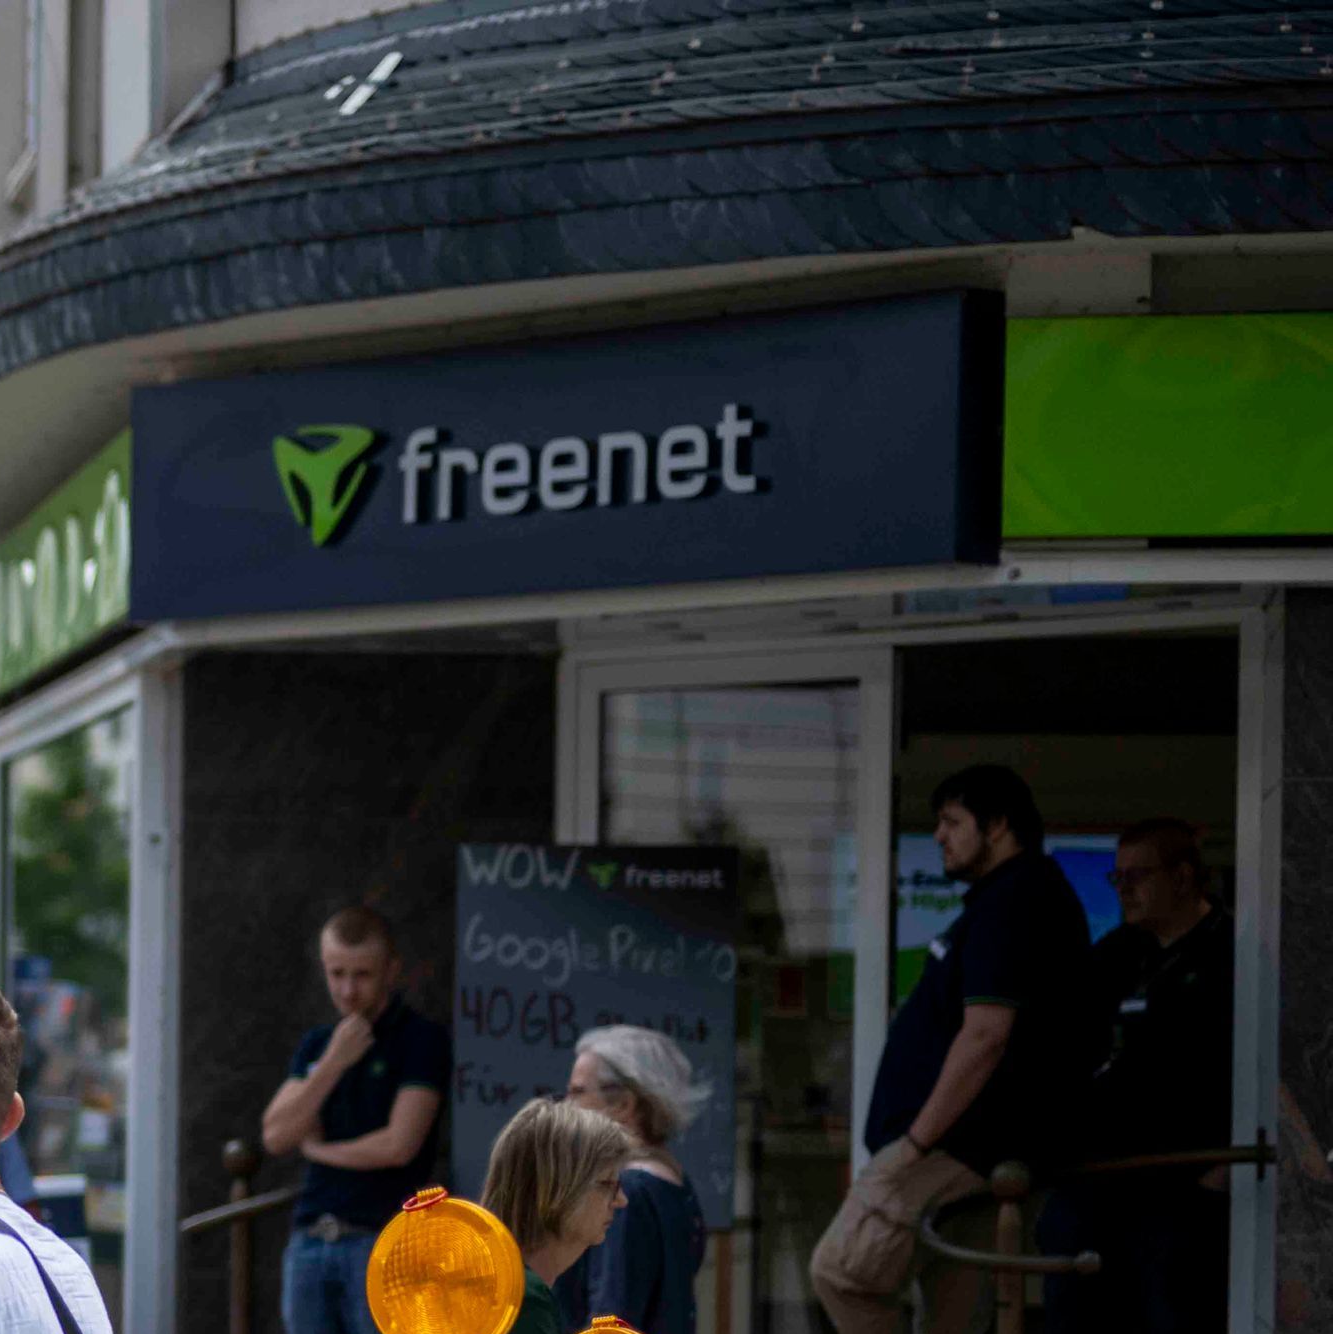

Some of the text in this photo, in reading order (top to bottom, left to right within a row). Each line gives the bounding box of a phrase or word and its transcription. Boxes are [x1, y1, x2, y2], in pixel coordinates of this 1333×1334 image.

[398, 402, 757, 525] freenet
[461, 843, 582, 890] WOW
[624, 866, 726, 889] freenet
[463, 911, 598, 987] Google
[459, 985, 577, 1049] 40GB
